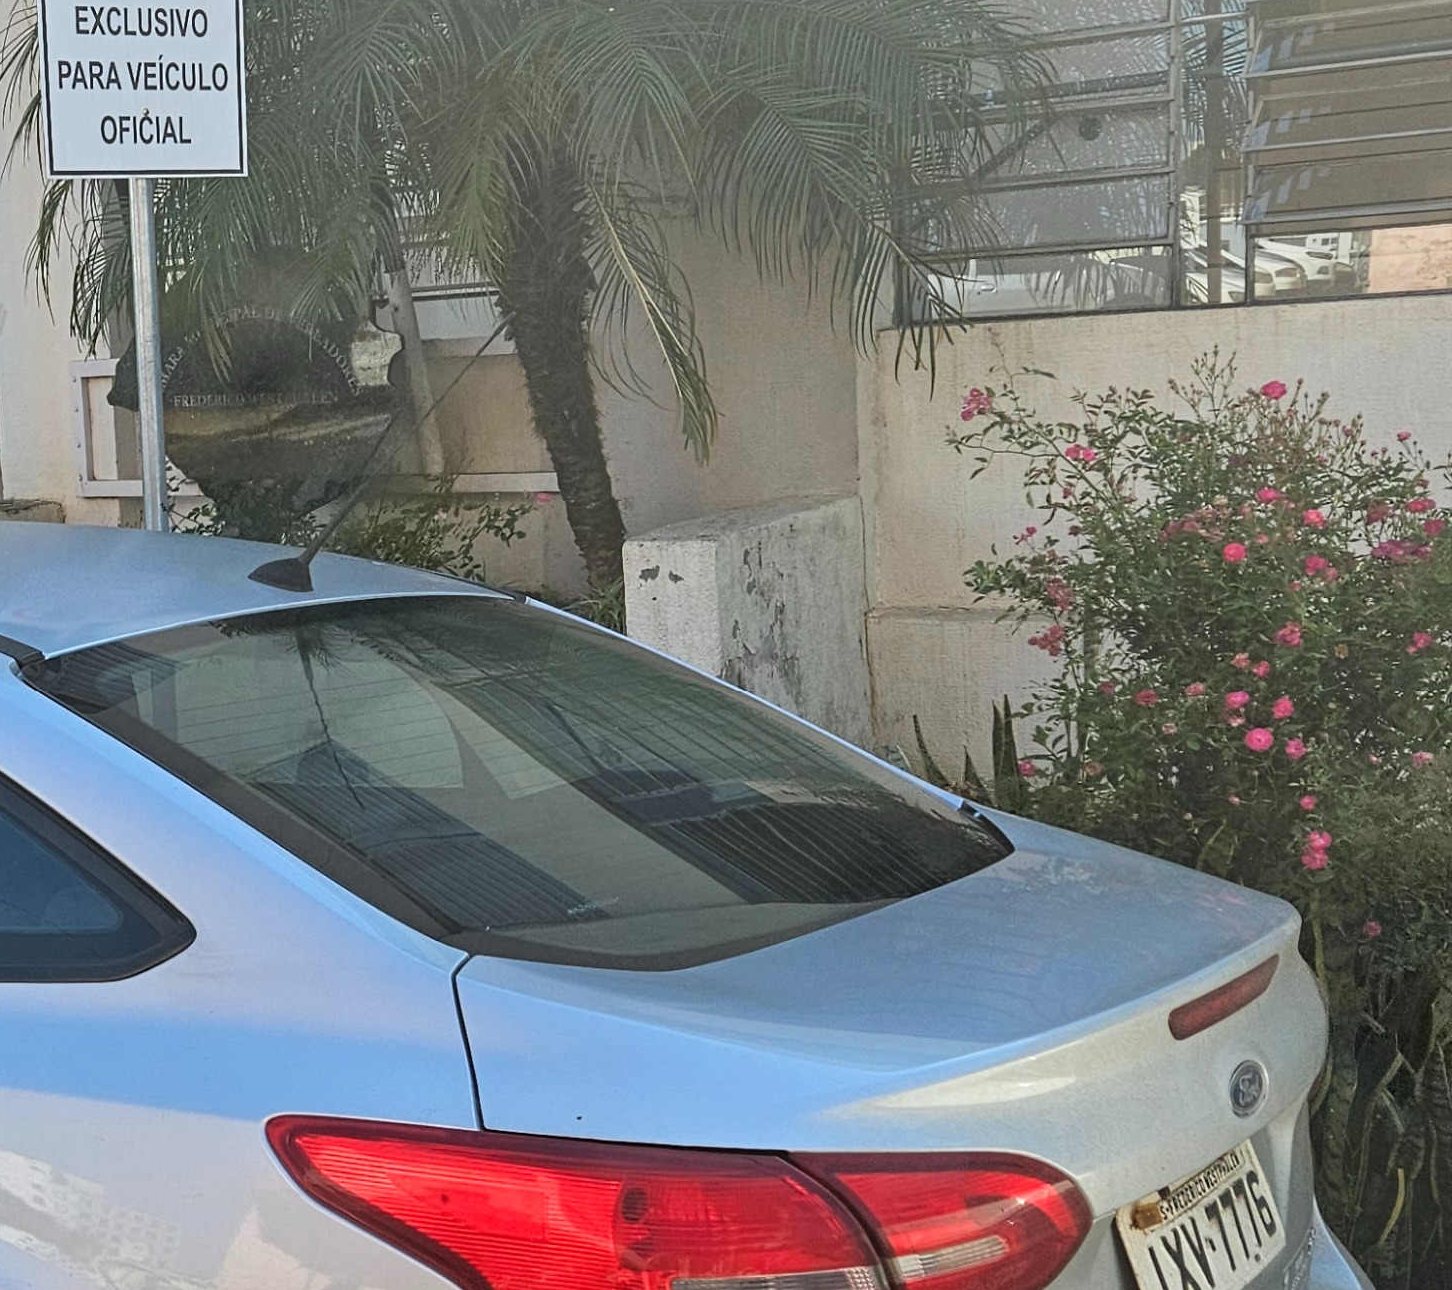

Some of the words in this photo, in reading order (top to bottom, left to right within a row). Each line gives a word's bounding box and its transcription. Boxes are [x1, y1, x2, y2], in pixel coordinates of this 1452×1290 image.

[74, 5, 208, 38] EXCLUSIVO
[58, 60, 122, 91] PARA
[126, 54, 228, 91] VEÍCULO
[100, 114, 192, 145] OFICIAL
